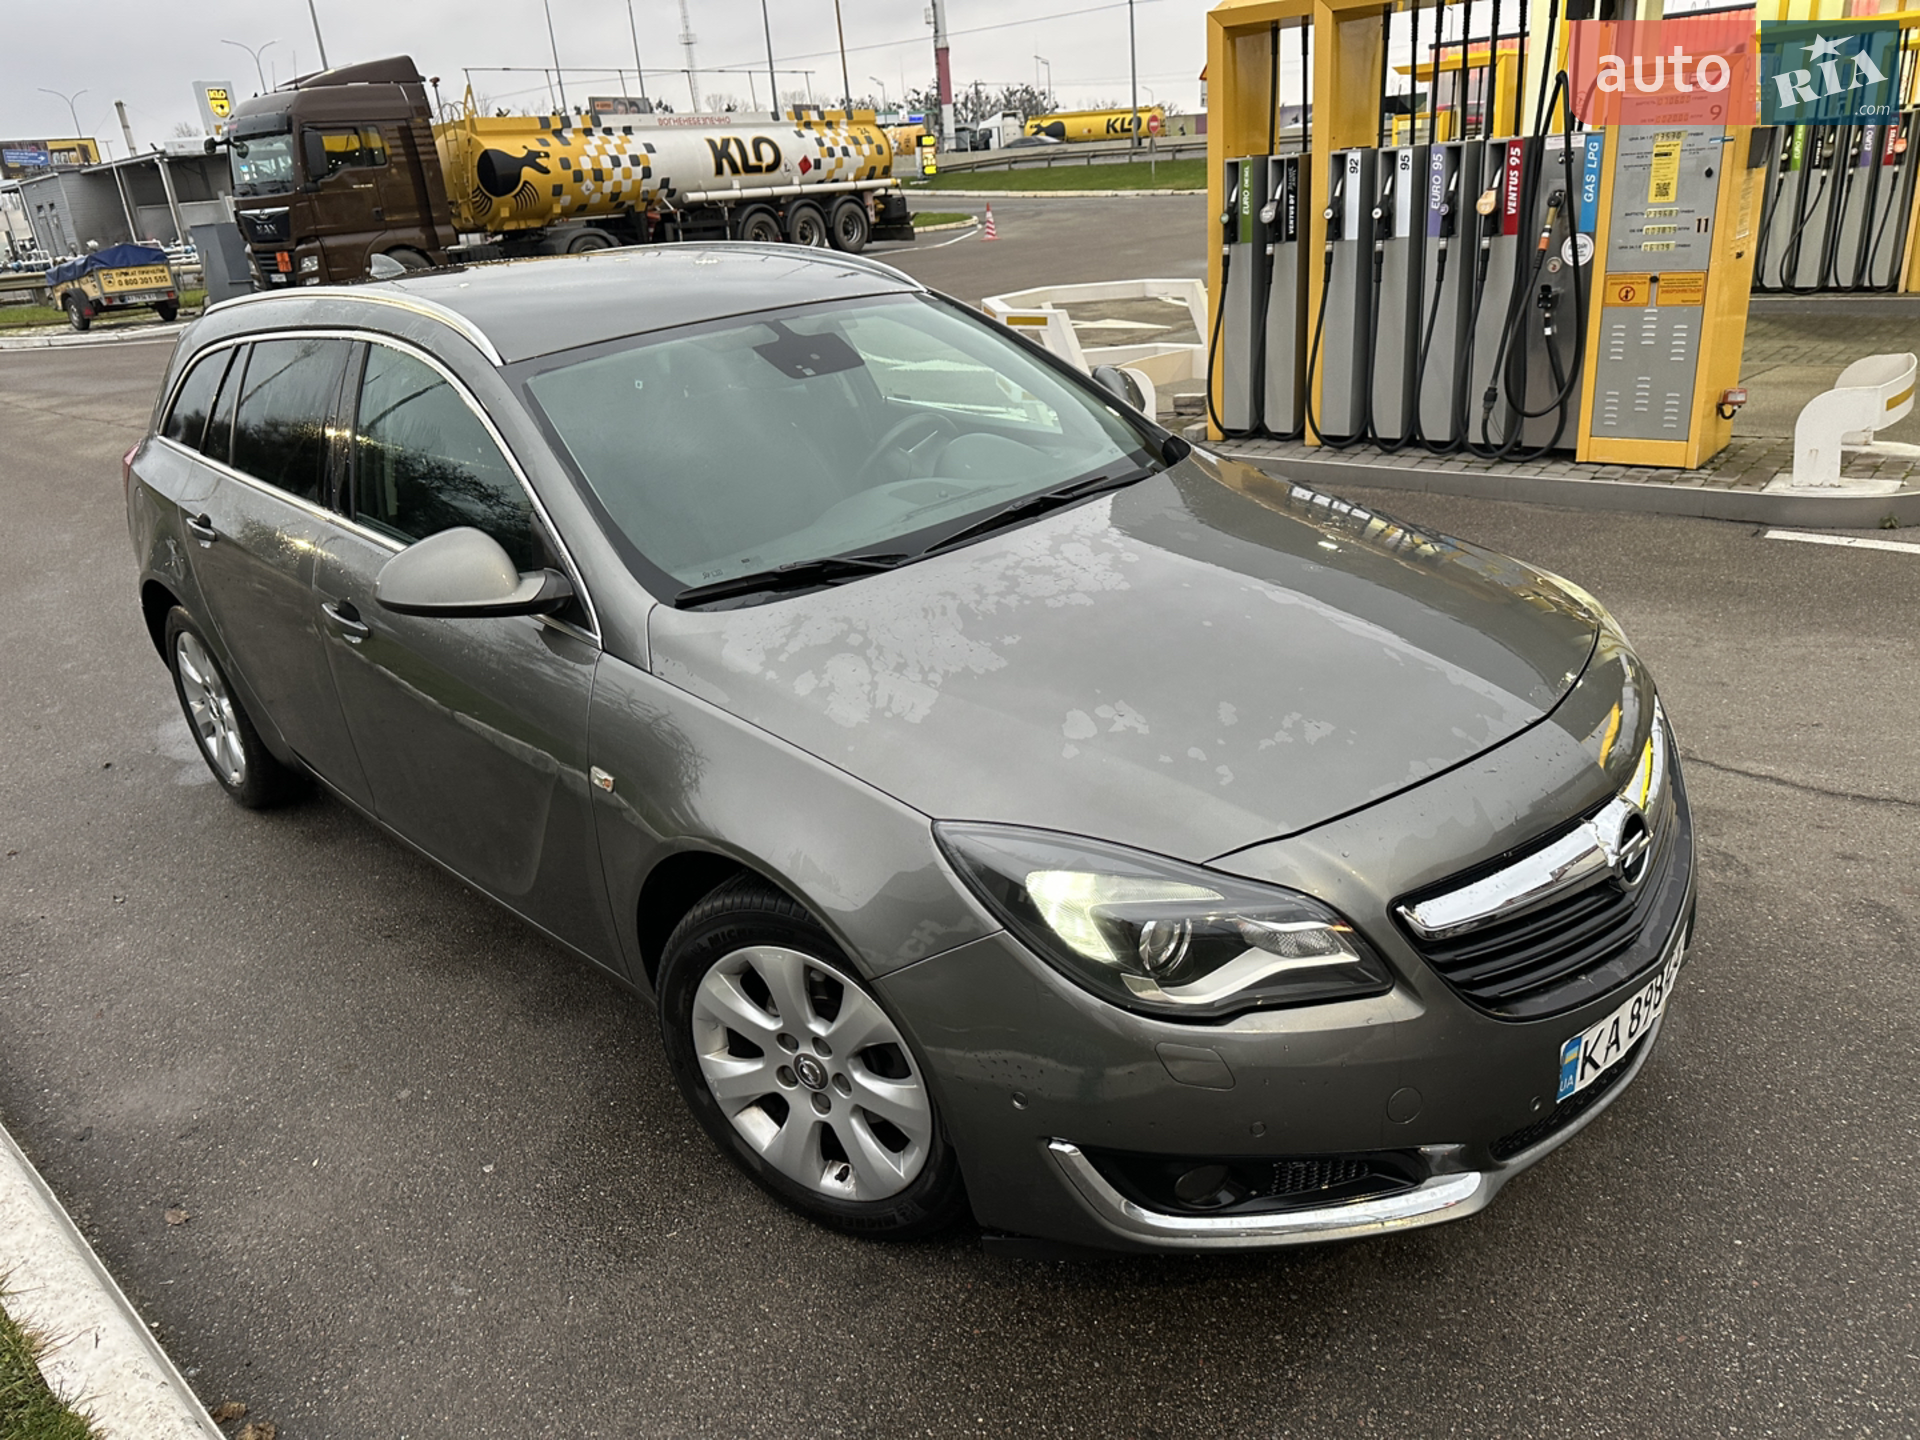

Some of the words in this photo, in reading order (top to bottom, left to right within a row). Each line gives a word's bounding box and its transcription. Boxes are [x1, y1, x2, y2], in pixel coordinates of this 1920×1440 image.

[657, 116, 731, 126] ВОГНЕНЕБЕЗПЕЧНО
[1710, 104, 1722, 121] 9
[705, 136, 782, 176] KLO
[1400, 154, 1410, 171] 95
[1432, 153, 1443, 170] 95
[1509, 147, 1521, 165] 95
[1587, 142, 1599, 168] LPG
[1349, 158, 1359, 174] 92
[1431, 175, 1442, 209] EURO
[1506, 170, 1519, 215] VENTUS
[1583, 174, 1596, 203] GAS
[1696, 218, 1709, 233] 11
[1580, 1016, 1621, 1082] KA
[1560, 1075, 1574, 1092] UA
